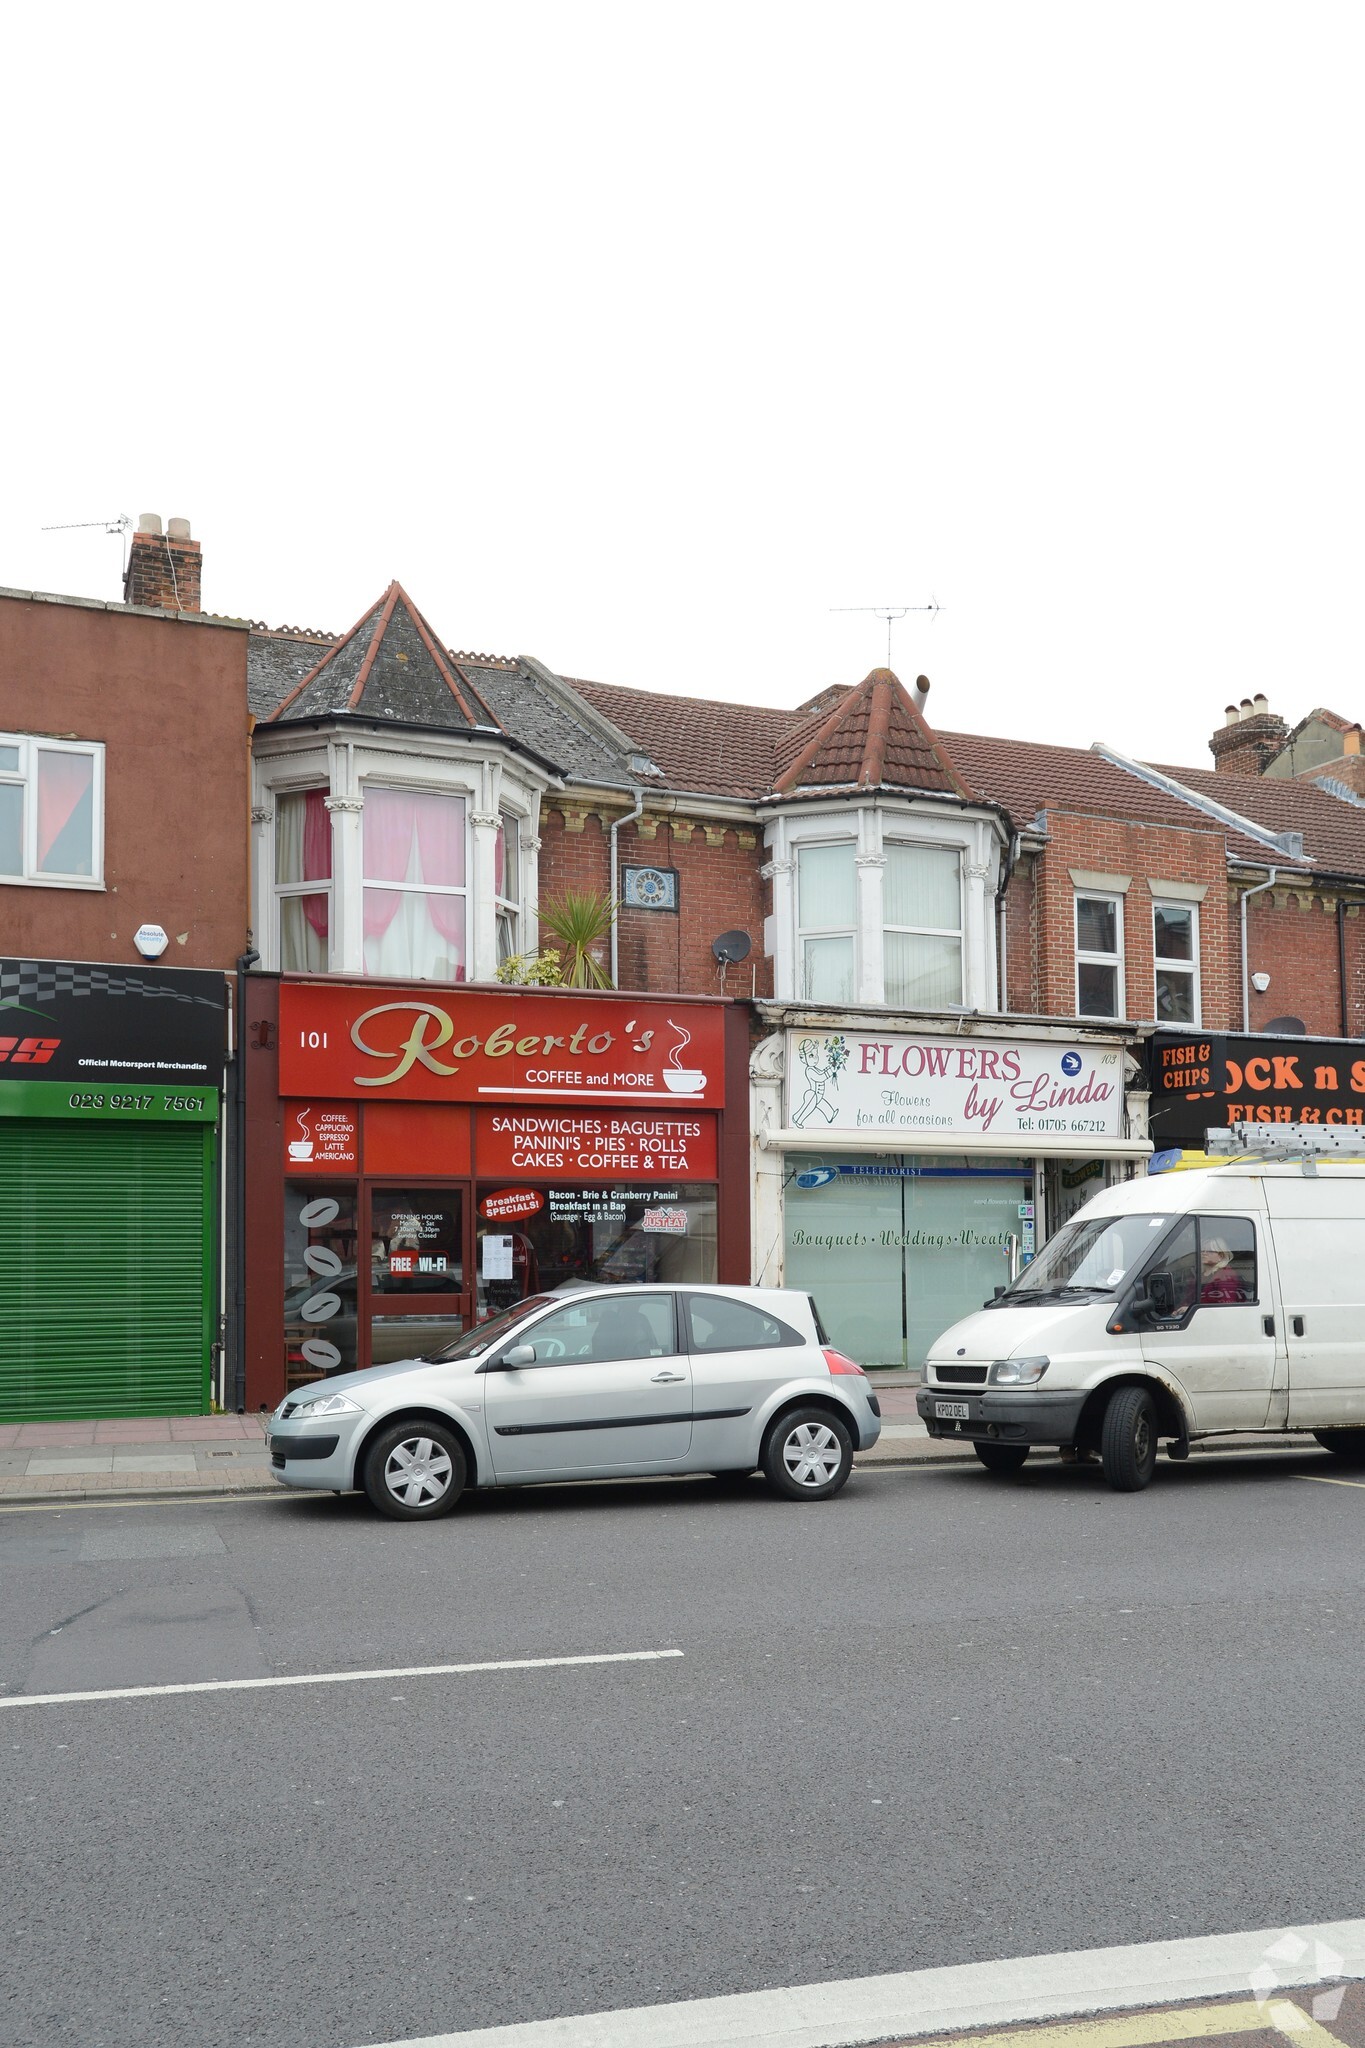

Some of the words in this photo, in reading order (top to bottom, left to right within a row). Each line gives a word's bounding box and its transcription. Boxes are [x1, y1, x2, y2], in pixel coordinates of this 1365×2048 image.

[139, 930, 164, 938] Absolute
[300, 1031, 328, 1049] 101
[350, 1001, 655, 1087] Roberto's
[857, 1043, 1021, 1081] FLOWERS
[1101, 1054, 1118, 1065] 103
[1162, 1046, 1196, 1067] FISH
[1198, 1044, 1211, 1062] &
[78, 1059, 108, 1067] Official
[110, 1060, 156, 1069] Motorsport
[157, 1061, 207, 1070] Merchandise
[525, 1070, 582, 1084] COFFEE
[586, 1073, 609, 1085] and
[613, 1073, 654, 1086] MORE
[1163, 1067, 1210, 1089] CHIPS
[1314, 1066, 1339, 1090] n
[1350, 1061, 1365, 1093] S
[69, 1093, 105, 1109] 023
[109, 1094, 155, 1110] 9217
[164, 1096, 206, 1112] 7561
[881, 1090, 931, 1107] Flowers
[963, 1083, 1004, 1131] by
[1010, 1070, 1115, 1112] Linda
[321, 1114, 348, 1122] COFFEE:
[856, 1109, 873, 1127] for
[878, 1110, 896, 1125] all
[900, 1114, 953, 1126] occasions
[1227, 1104, 1293, 1125] FISH
[1300, 1106, 1320, 1125] &
[1326, 1108, 1365, 1126] CH
[315, 1123, 354, 1132] CAPPUCINO
[492, 1117, 601, 1134] SANDWICHES
[611, 1120, 701, 1136] BAGUETTES
[1017, 1117, 1034, 1130] Tel:
[1038, 1119, 1067, 1131] 01705
[1071, 1120, 1106, 1132] 667212
[319, 1133, 350, 1141] ESPRESSO
[514, 1136, 581, 1150] PANINI'S
[595, 1138, 625, 1151] PIES
[639, 1139, 686, 1153] ROLLS
[315, 1152, 354, 1160] AMERICANO
[512, 1152, 563, 1167] CAKES
[577, 1154, 638, 1168] COFFEE
[643, 1156, 655, 1169] &
[658, 1156, 689, 1169] TEA
[851, 1166, 923, 1176] TELEFLORIST
[486, 1191, 535, 1207] Breakfast
[549, 1190, 575, 1199] Bacon
[582, 1190, 599, 1199] Brie
[602, 1190, 608, 1199] &
[611, 1191, 651, 1201] Cranberry
[653, 1191, 678, 1199] Panini
[486, 1201, 540, 1217] SPECIALS!
[550, 1202, 590, 1210] Breakfast
[610, 1202, 626, 1212] Bap
[550, 1212, 578, 1222] (Sausage
[584, 1212, 596, 1222] Egg
[597, 1212, 603, 1220] &
[604, 1212, 626, 1222] Bacon)
[645, 1218, 666, 1227] JUST
[667, 1218, 686, 1227] EAT
[792, 1229, 867, 1250] Bouquets
[879, 1230, 952, 1250] Weddings
[391, 1257, 411, 1271] FREE
[418, 1257, 446, 1271] WI-FI
